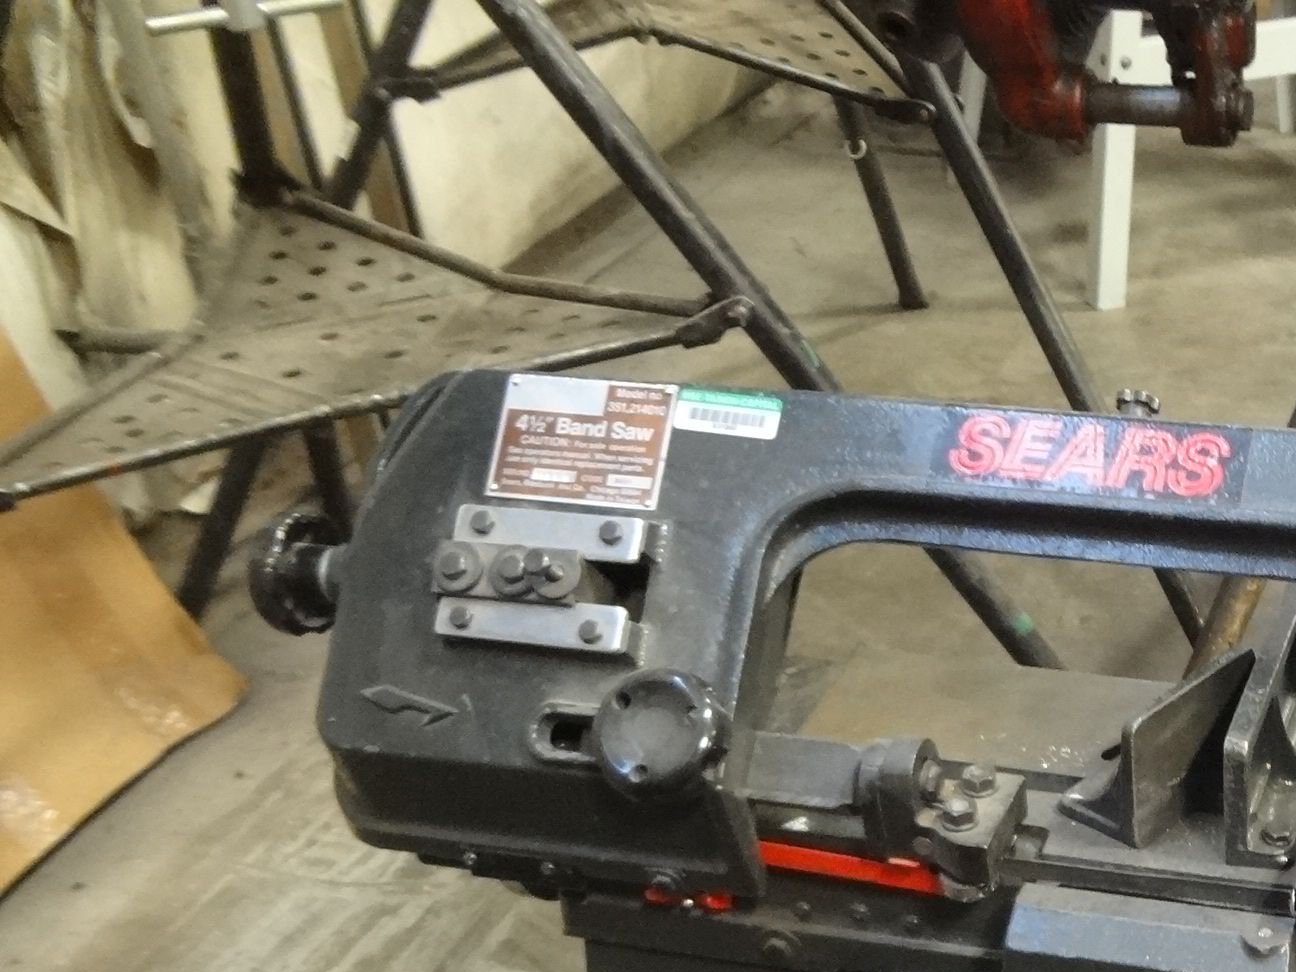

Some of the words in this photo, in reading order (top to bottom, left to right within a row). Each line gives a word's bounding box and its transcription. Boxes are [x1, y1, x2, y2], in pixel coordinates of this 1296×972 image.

[554, 417, 608, 437] Band
[609, 422, 655, 441] Saw
[949, 415, 1231, 497] SEARS
